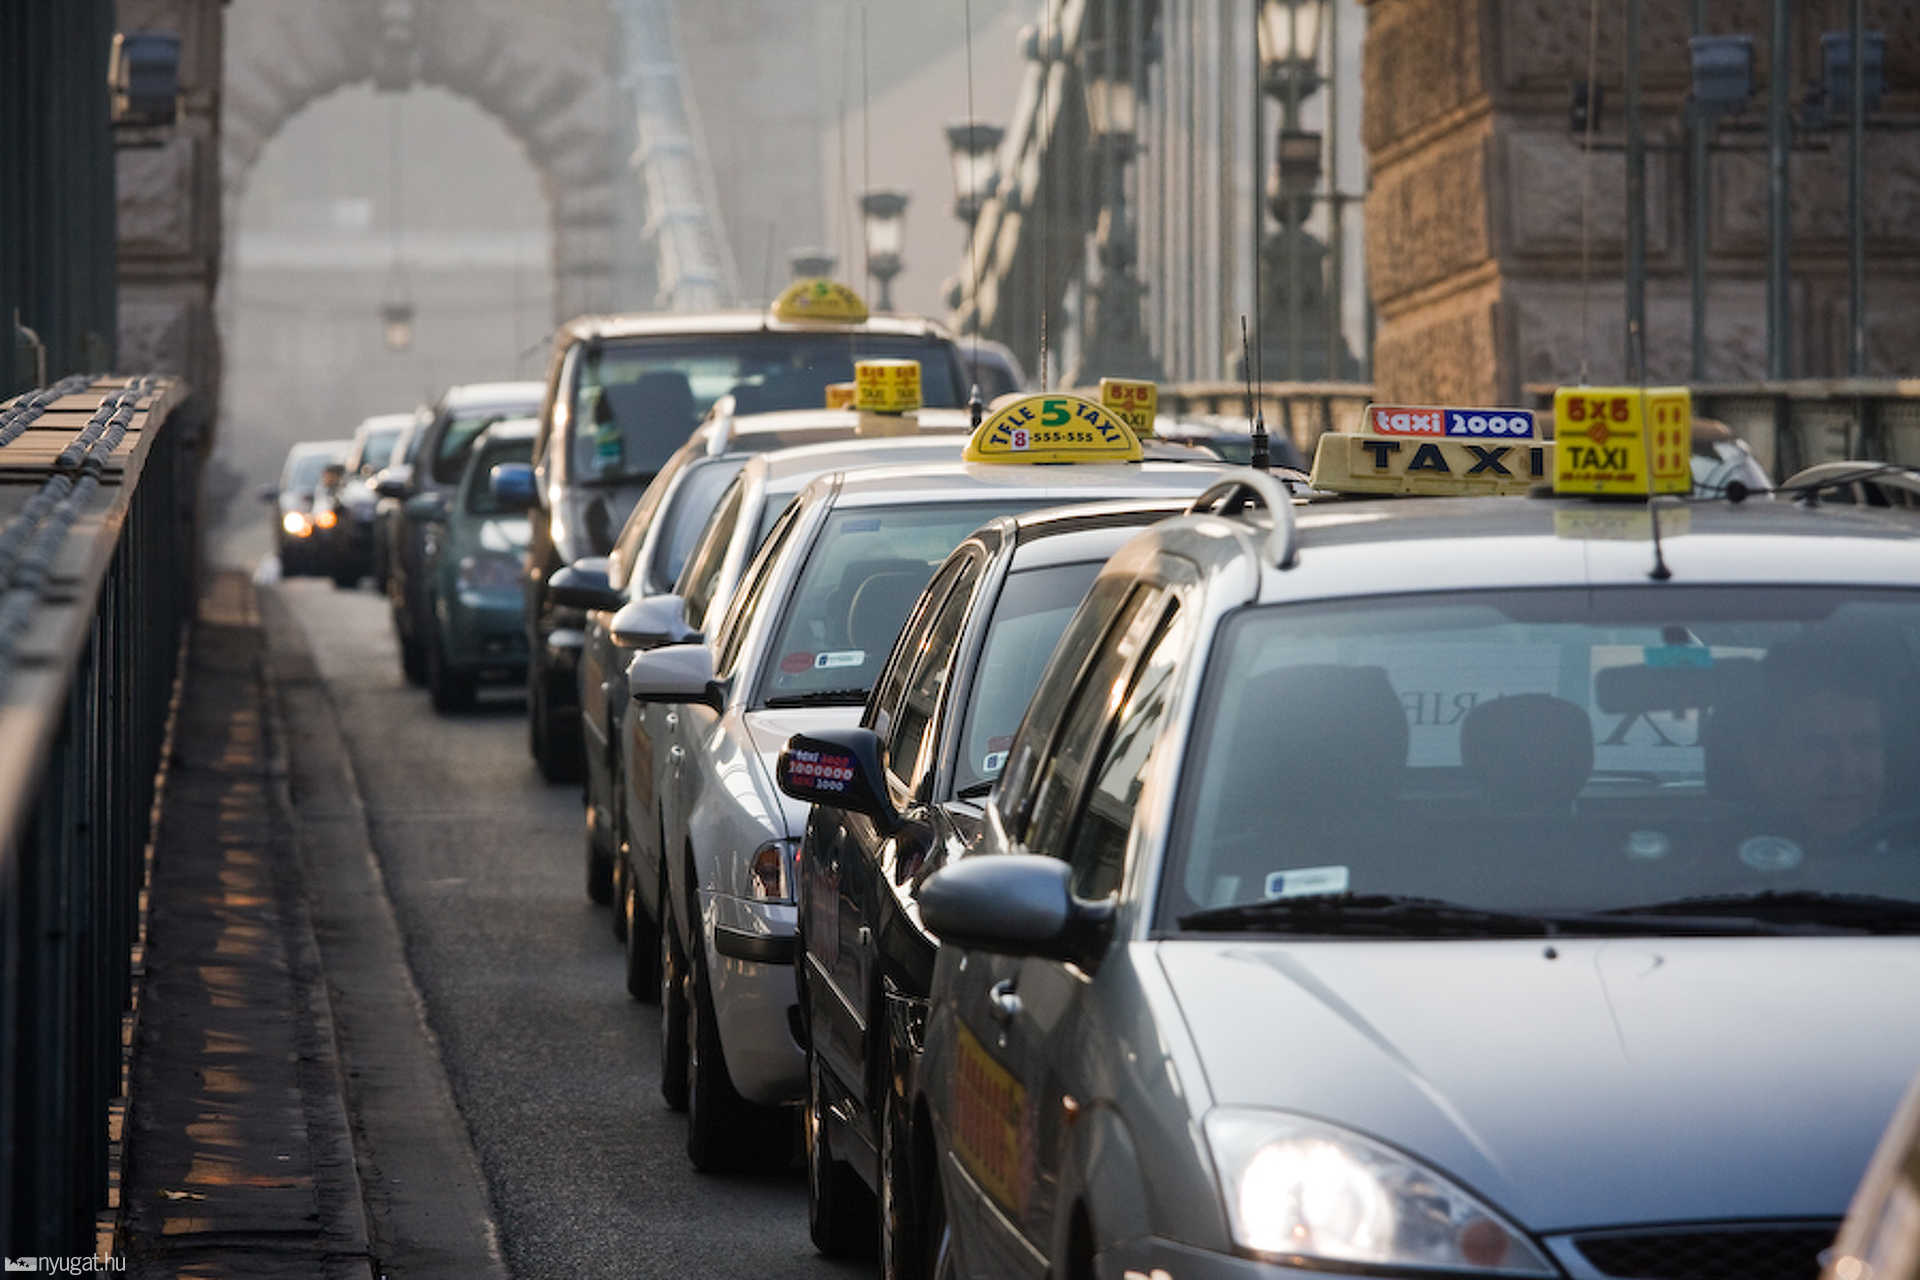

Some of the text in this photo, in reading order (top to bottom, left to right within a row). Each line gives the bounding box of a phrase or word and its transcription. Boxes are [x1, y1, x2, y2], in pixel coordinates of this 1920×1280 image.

[989, 400, 1121, 445] TELE 5 TAXI
[1376, 410, 1530, 435] taxi 2000
[1362, 440, 1544, 477] TAXI
[1566, 447, 1628, 470] TAXI
